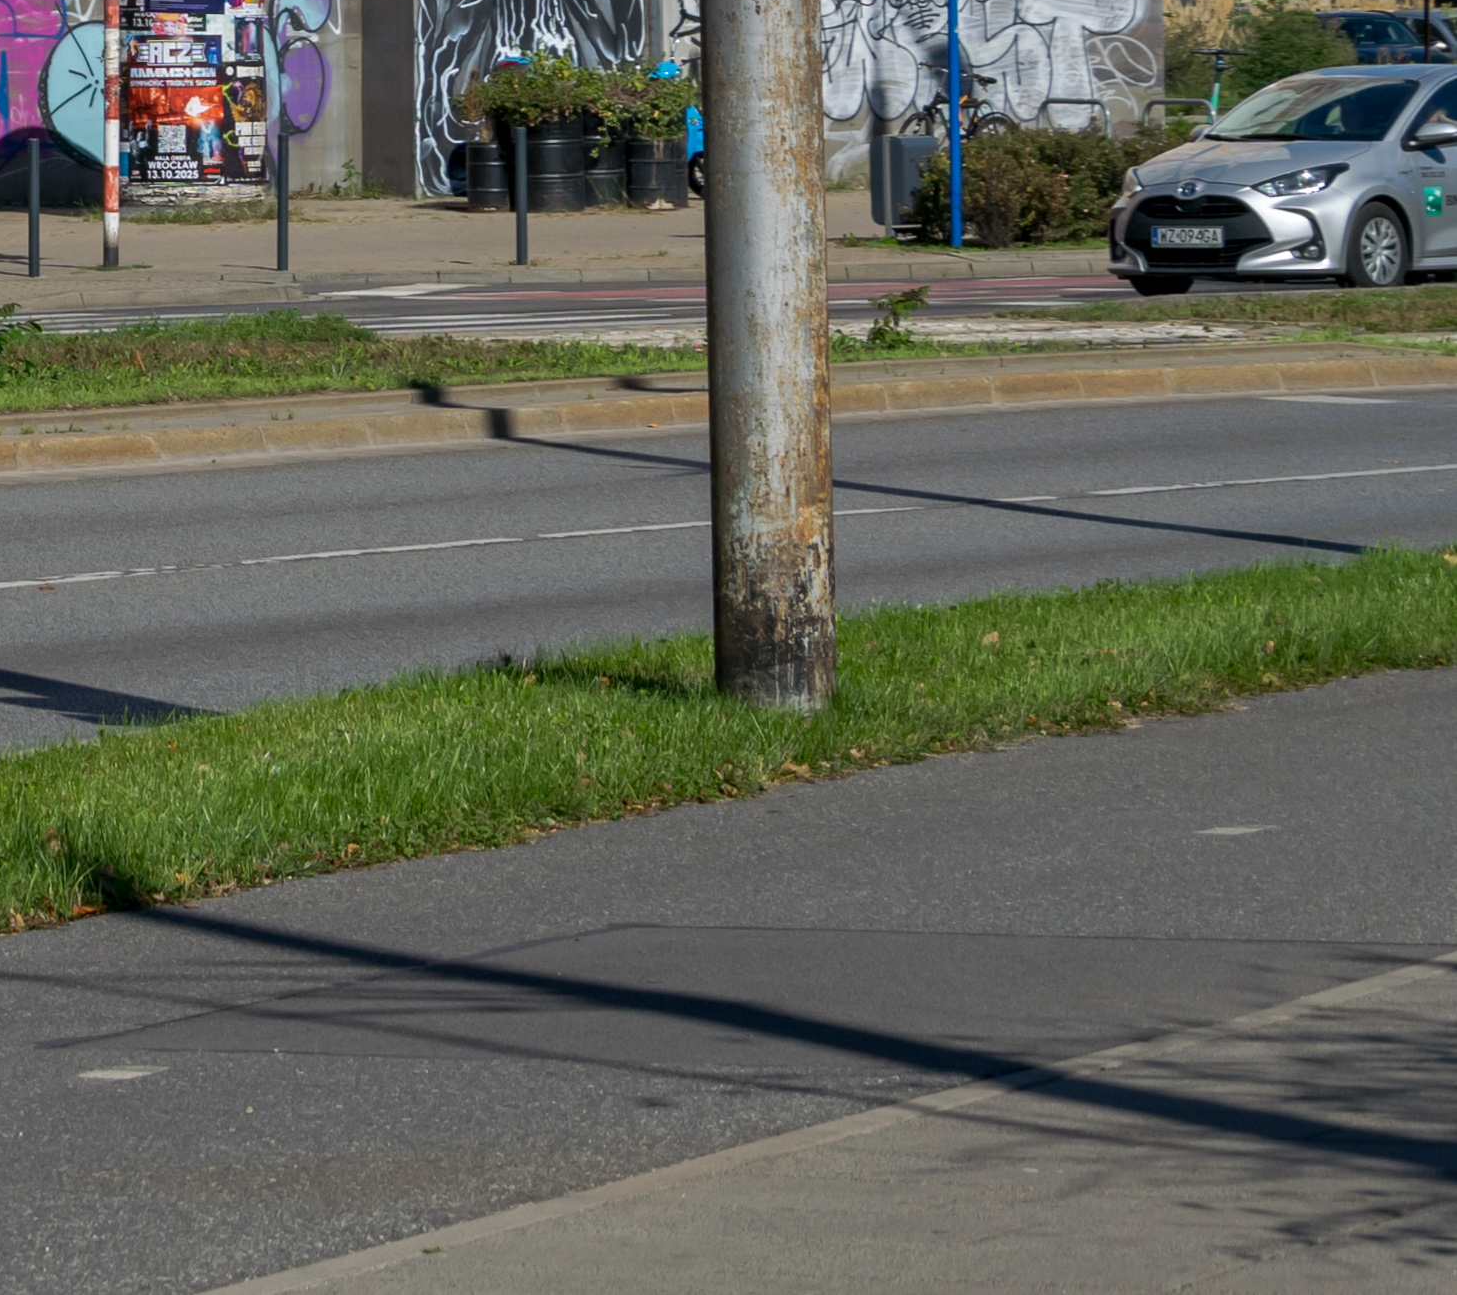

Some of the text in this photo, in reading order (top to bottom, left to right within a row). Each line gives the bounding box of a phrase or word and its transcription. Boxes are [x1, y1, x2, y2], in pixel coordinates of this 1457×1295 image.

[147, 169, 199, 180] 13.10.2025
[1157, 228, 1219, 243] WZ 094GA
